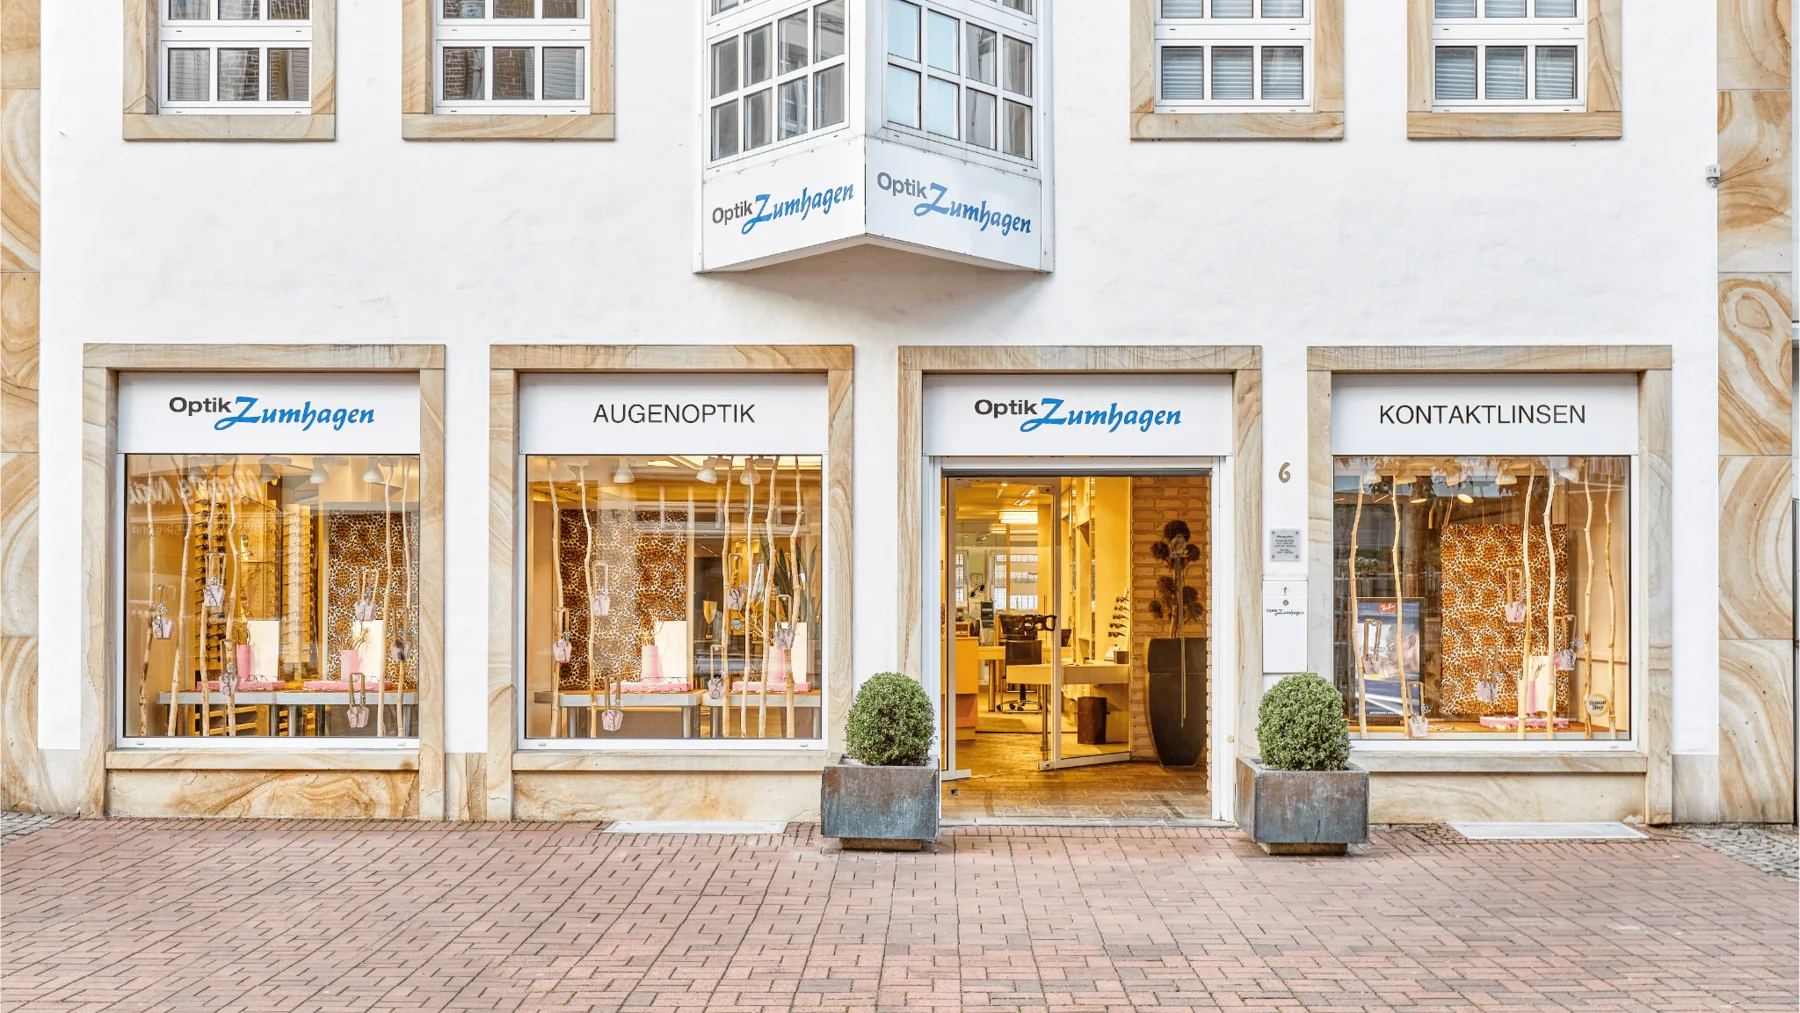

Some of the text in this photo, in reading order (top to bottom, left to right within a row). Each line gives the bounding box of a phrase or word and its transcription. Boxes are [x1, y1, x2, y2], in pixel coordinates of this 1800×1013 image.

[712, 184, 854, 235] Optik Zumhagen
[877, 172, 1032, 236] Optik Zumhagen
[169, 396, 375, 431] Optik Zumhagen
[593, 404, 756, 424] AUGENOPTIK
[974, 398, 1181, 433] Optik Zumhagen
[1380, 404, 1586, 424] KONTAKTLINSEN
[1278, 461, 1291, 483] 6
